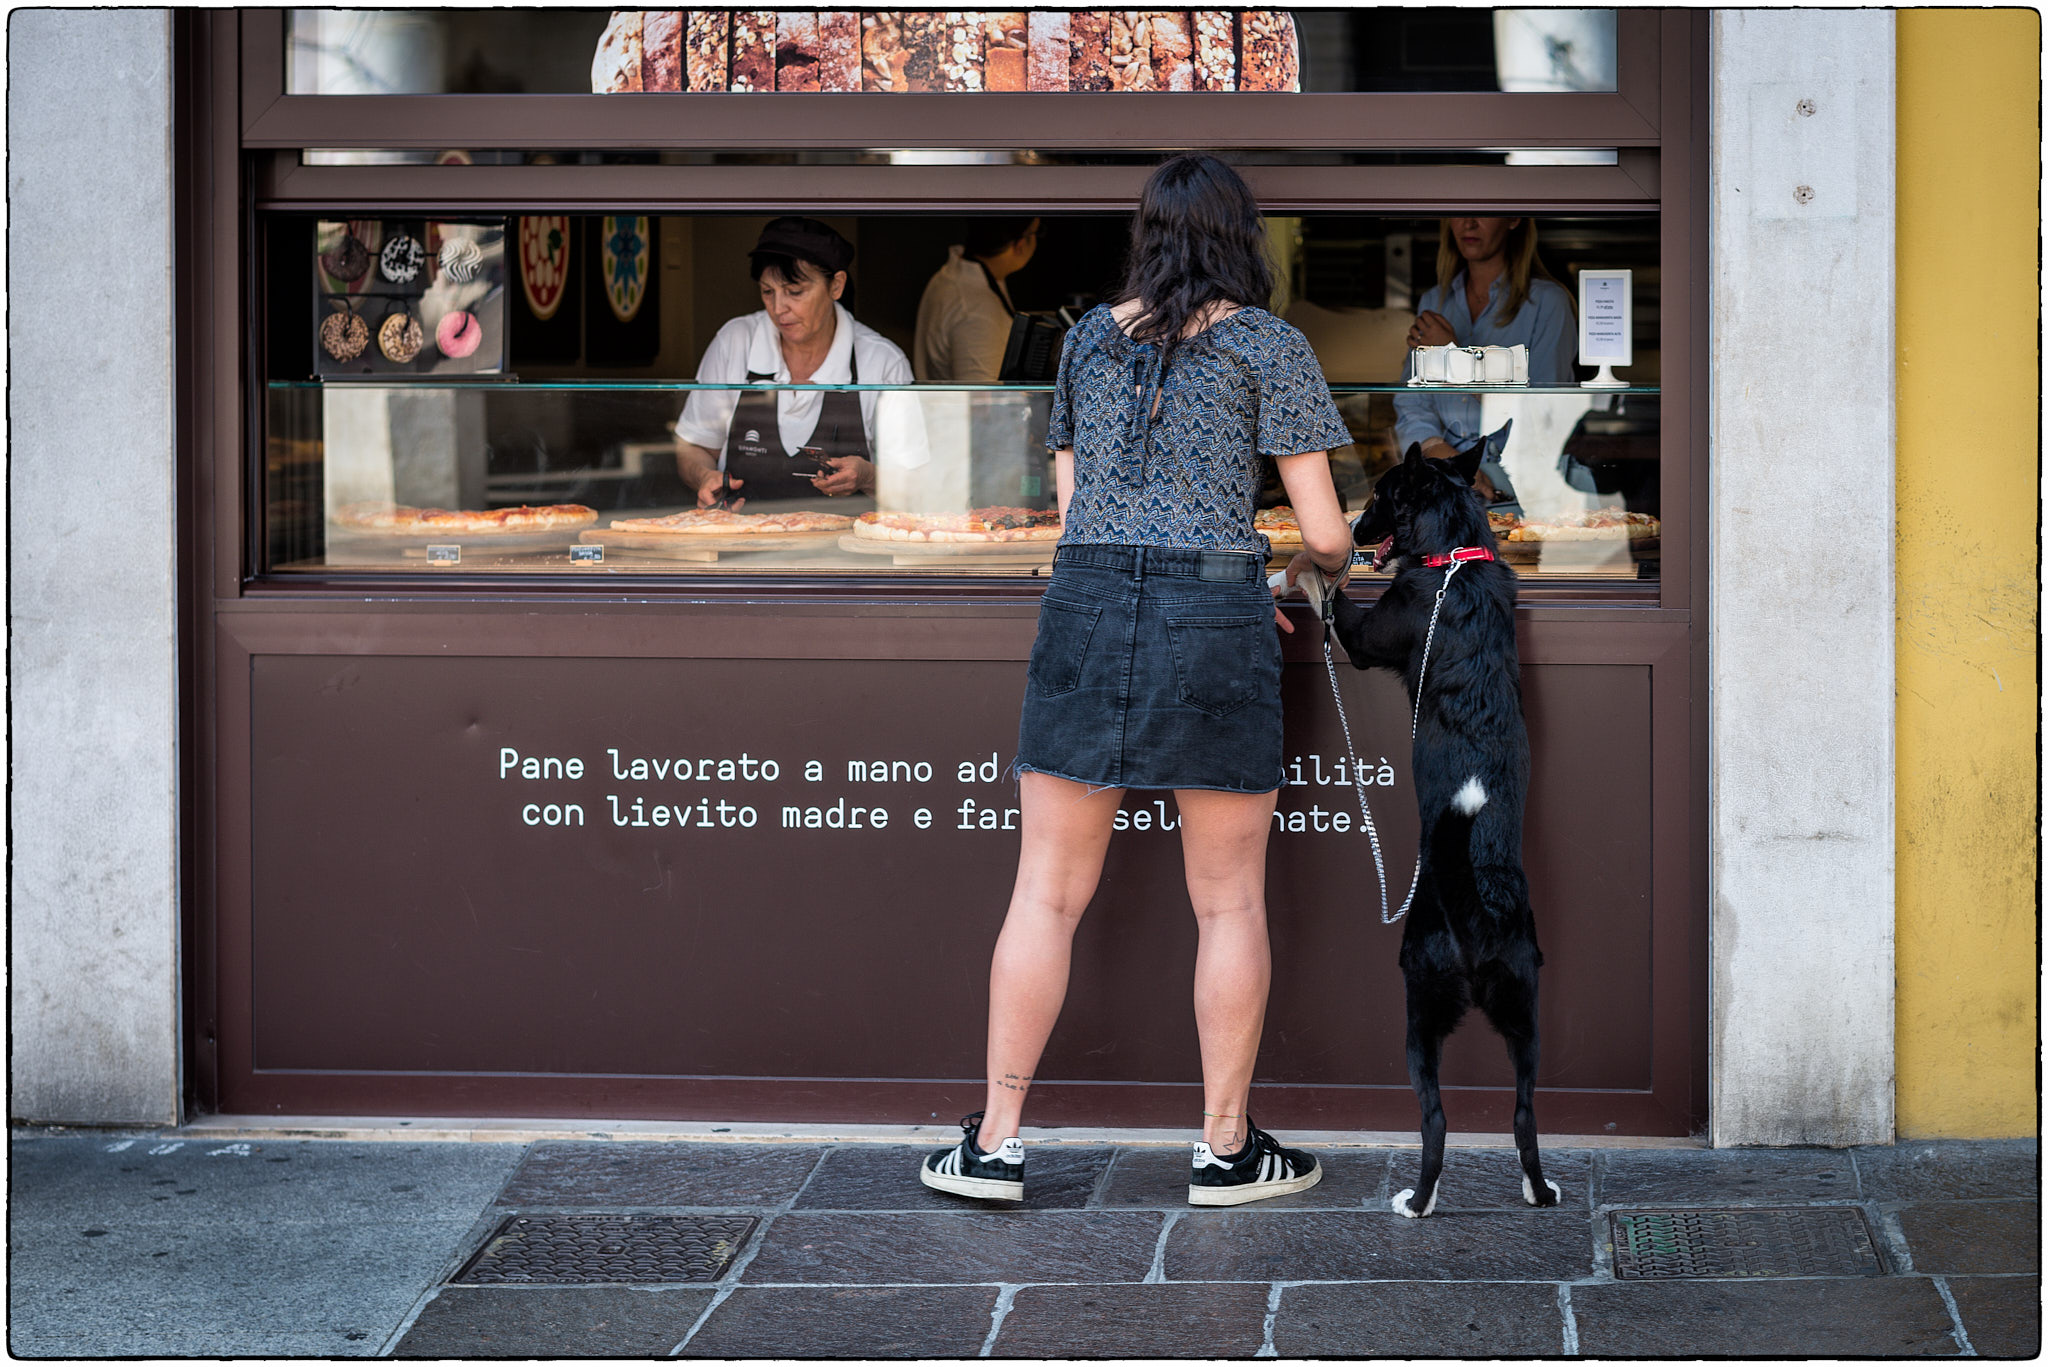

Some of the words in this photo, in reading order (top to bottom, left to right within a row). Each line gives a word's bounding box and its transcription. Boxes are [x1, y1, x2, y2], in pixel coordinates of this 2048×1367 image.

[500, 747, 585, 780] Pane
[606, 748, 780, 782] lavorato
[804, 760, 823, 782] a
[848, 760, 933, 783] mano
[957, 752, 998, 783] ad
[1281, 754, 1395, 787] ilità
[522, 803, 584, 827] con
[606, 795, 758, 828] lievito
[782, 797, 889, 829] madre
[913, 807, 933, 829] e
[957, 798, 1021, 831] far
